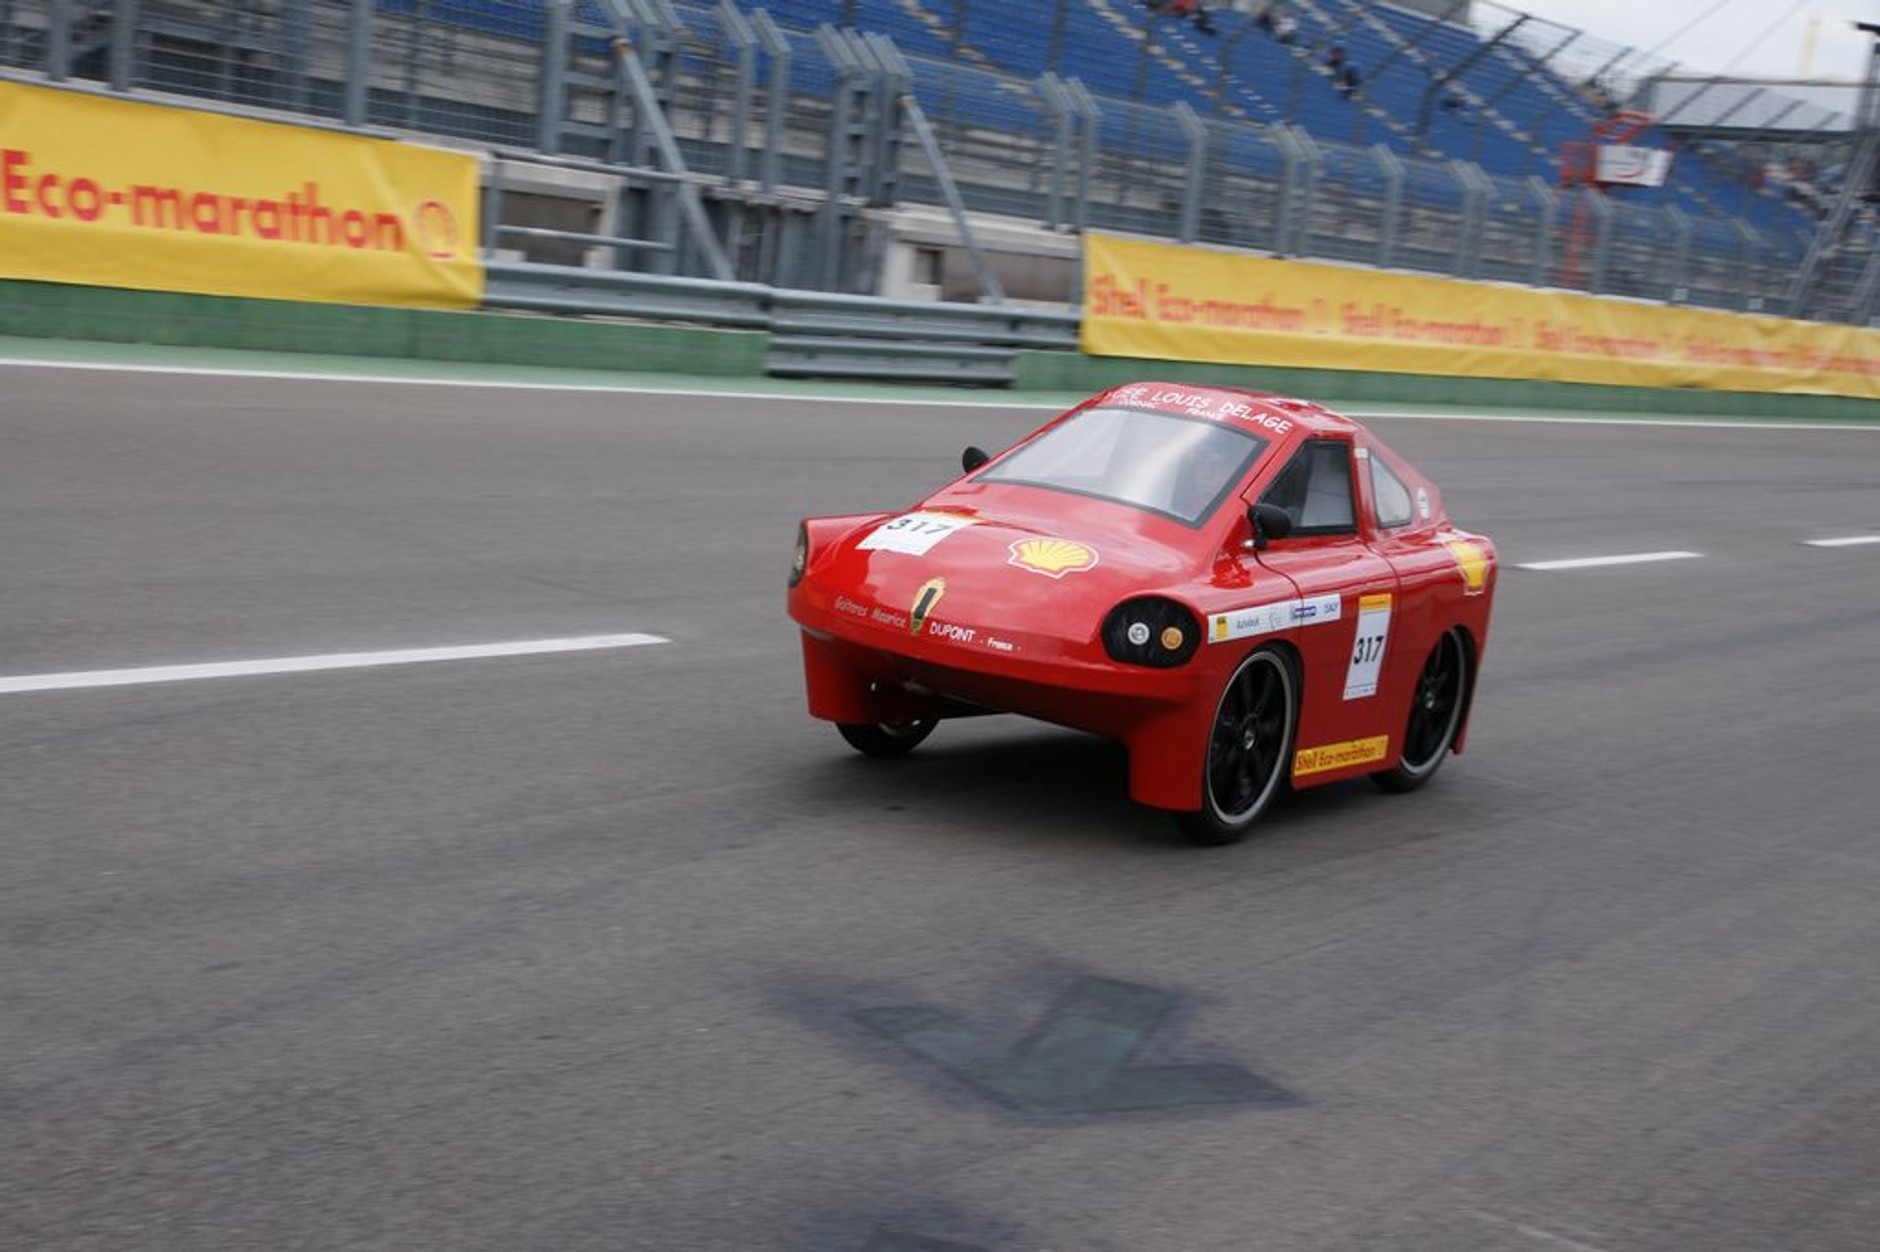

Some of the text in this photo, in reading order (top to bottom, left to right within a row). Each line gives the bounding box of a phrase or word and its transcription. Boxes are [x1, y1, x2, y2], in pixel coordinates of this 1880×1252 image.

[1, 149, 407, 252] Eco-marathon
[1093, 275, 1148, 319] Shell
[1151, 391, 1213, 409] LOUIS
[1219, 401, 1293, 434] DELAGE
[886, 518, 953, 535] 317
[929, 621, 976, 642] DUPONT
[1353, 635, 1385, 665] 317
[1296, 750, 1318, 772] Shell
